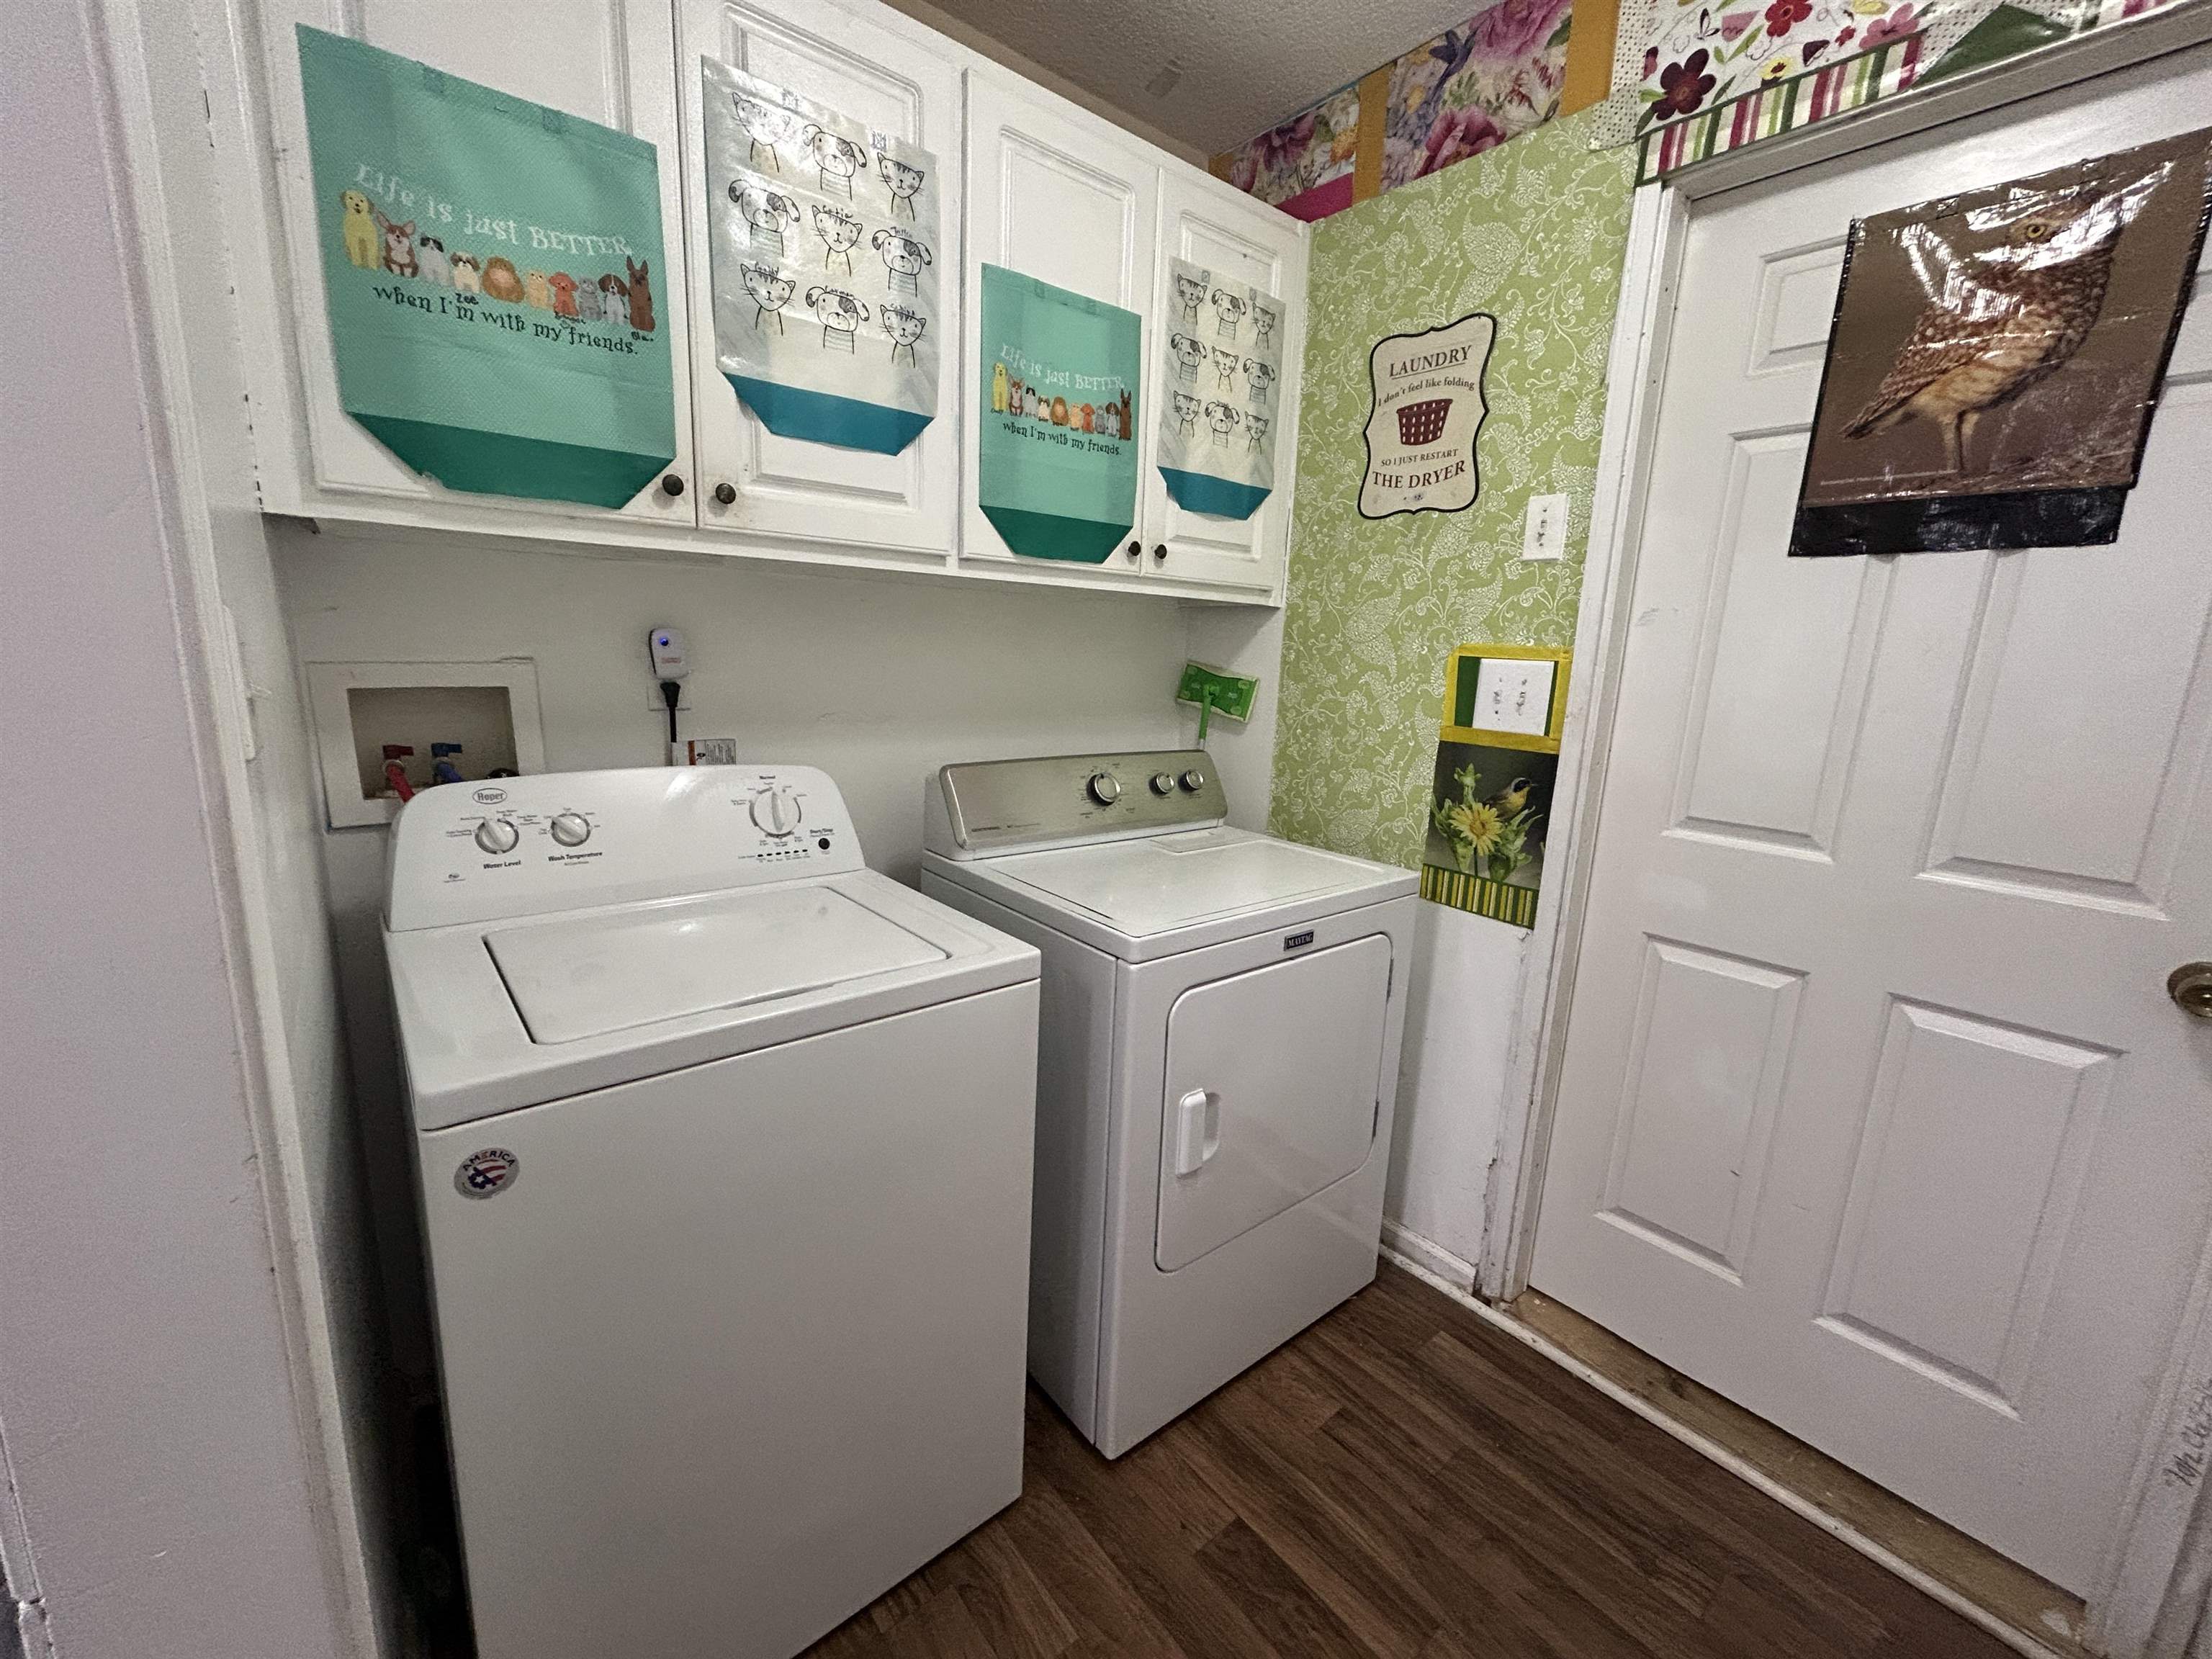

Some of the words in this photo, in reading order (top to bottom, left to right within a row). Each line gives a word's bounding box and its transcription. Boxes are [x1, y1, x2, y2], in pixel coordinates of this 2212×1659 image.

[354, 163, 415, 207] Life
[428, 198, 453, 222] is
[464, 213, 519, 246] just
[529, 225, 632, 256] BETTER
[373, 285, 432, 314] when
[440, 296, 475, 322] I'm
[481, 312, 526, 333] with
[533, 323, 562, 342] my
[569, 326, 638, 355] friends.
[1002, 344, 1025, 369] Life
[1030, 362, 1043, 378] is
[1046, 370, 1071, 388] just
[1074, 373, 1125, 391] BETTER
[1389, 345, 1473, 377] LAUNDRY
[1383, 387, 1406, 404] don't
[1408, 381, 1424, 394] feel
[1425, 378, 1442, 389] like
[1444, 376, 1475, 391] folding
[1003, 421, 1027, 438] when
[1030, 425, 1046, 441] I'm
[1049, 433, 1069, 446] with
[1071, 439, 1085, 450] my
[1088, 439, 1123, 456] friends.
[1381, 458, 1392, 467] SO
[1398, 454, 1419, 466] JUST
[1420, 448, 1459, 462] RESTART
[1372, 471, 1403, 489] THE
[1408, 459, 1465, 490] DRYER
[477, 791, 505, 802] Roper
[1288, 932, 1313, 947] MAYTAG
[462, 1150, 516, 1172] AMERICA
